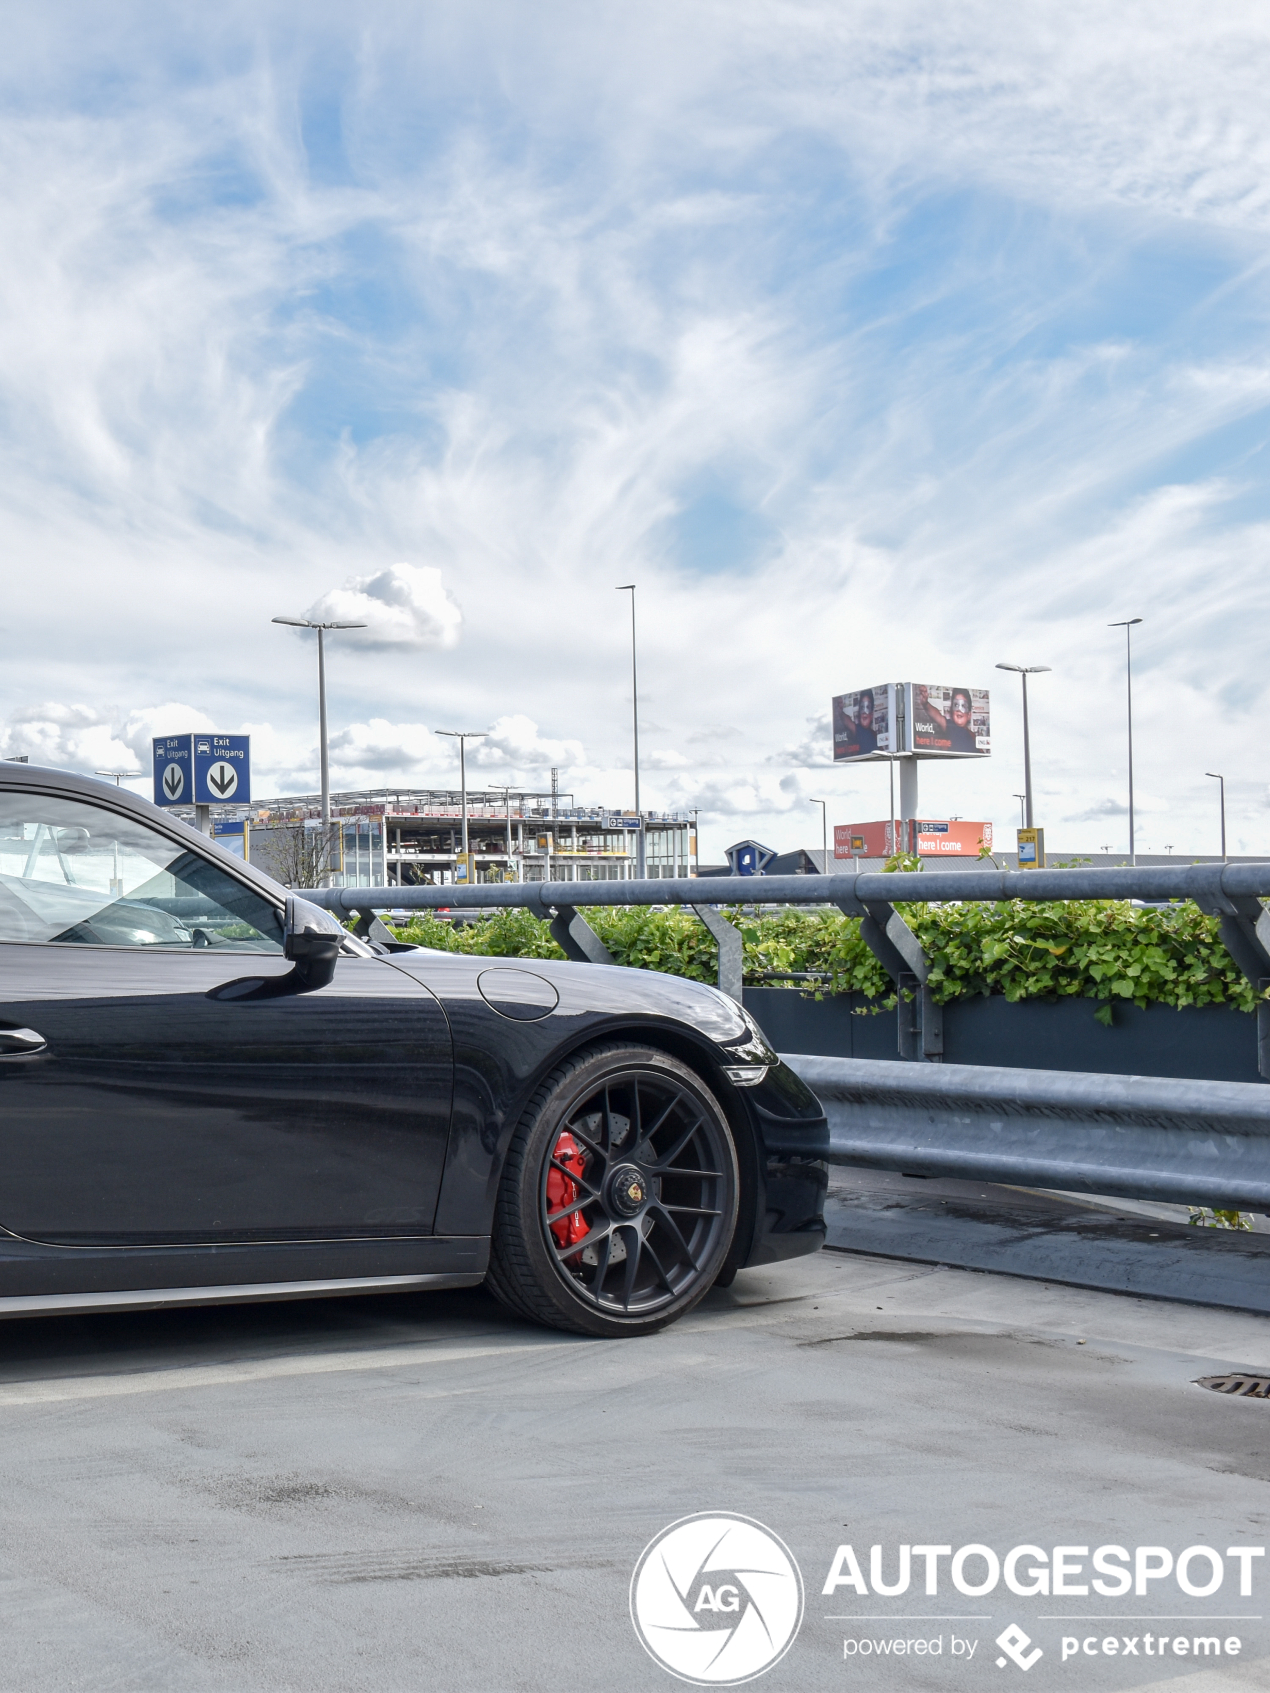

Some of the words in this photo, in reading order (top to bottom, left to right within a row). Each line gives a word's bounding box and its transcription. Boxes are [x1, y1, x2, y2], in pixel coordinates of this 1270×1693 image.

[915, 722, 935, 734] World,
[167, 739, 179, 748] Exit
[213, 737, 230, 746] Exit
[167, 750, 189, 760] Uitgang
[213, 748, 244, 759] Uitgang
[835, 828, 852, 840] World
[835, 843, 849, 854] here
[918, 838, 936, 851] here
[940, 841, 962, 851] come
